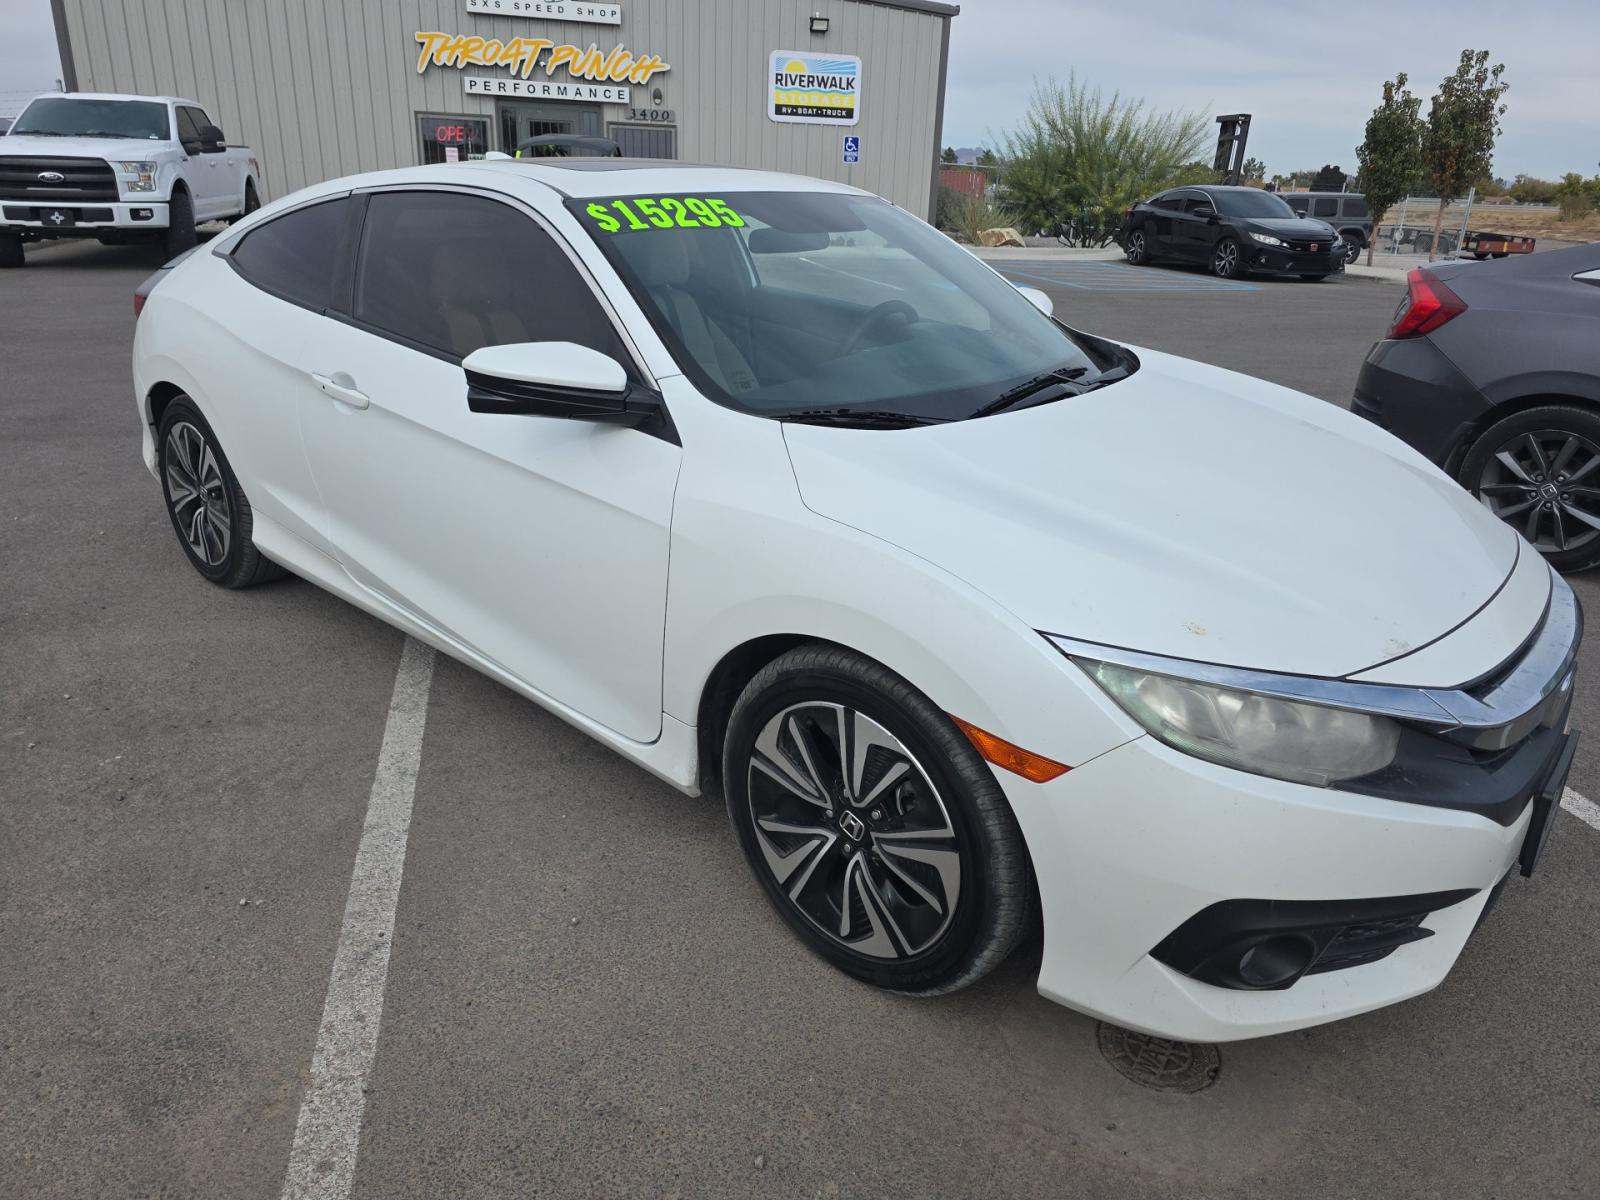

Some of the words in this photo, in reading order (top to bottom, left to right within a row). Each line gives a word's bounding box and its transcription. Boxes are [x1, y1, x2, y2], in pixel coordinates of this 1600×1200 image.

[514, 3, 565, 14] SPEED
[576, 8, 617, 17] SHOP
[415, 31, 554, 80] THROAT
[546, 43, 671, 84] PUNCH
[469, 80, 626, 99] PERFORMANCE
[775, 73, 856, 91] RIVERWALK
[631, 108, 670, 120] 3400
[822, 108, 847, 116] TRUCK
[436, 126, 468, 142] OPE
[586, 198, 745, 232] $15295
